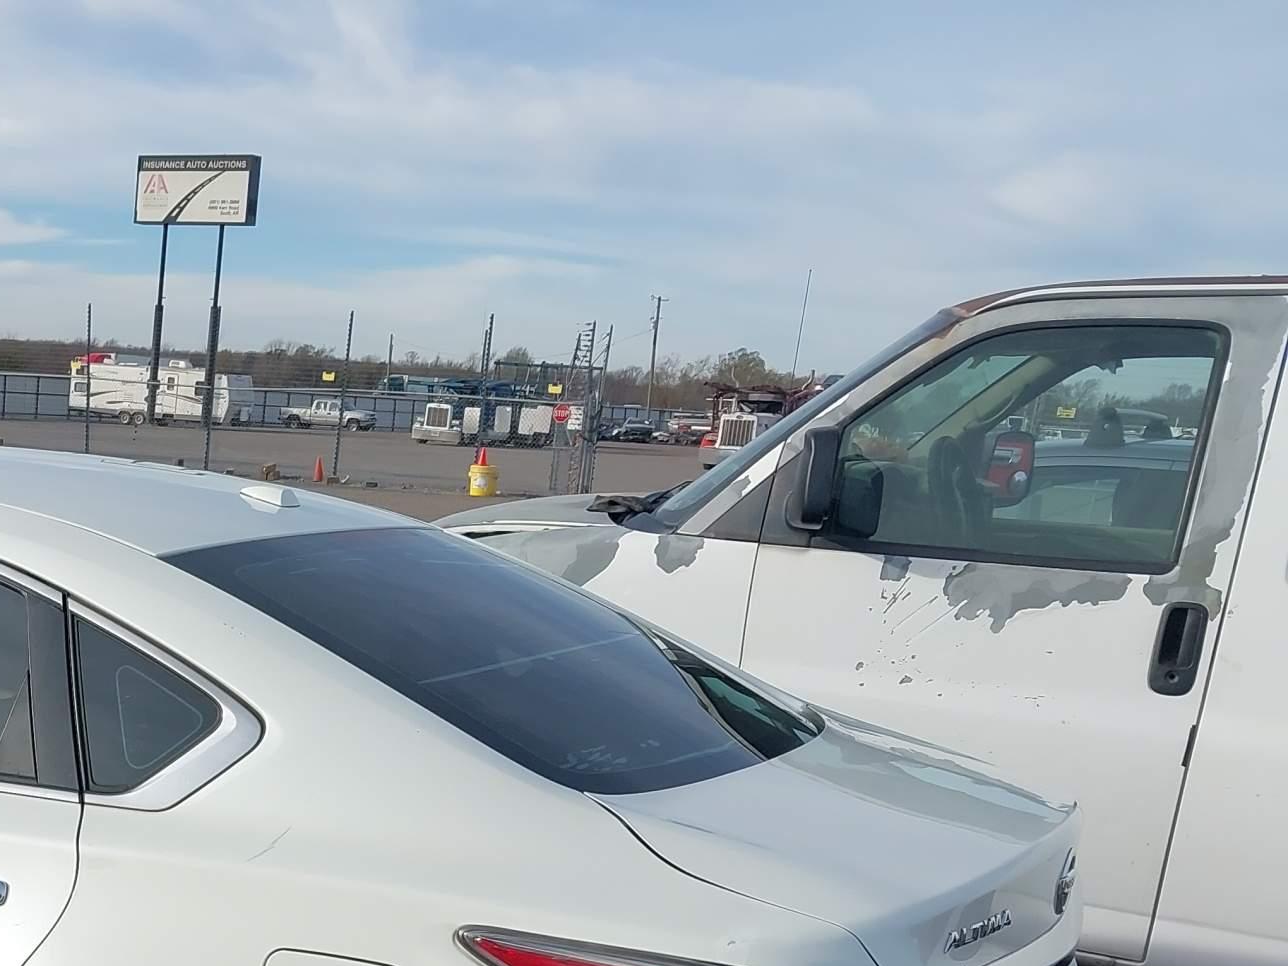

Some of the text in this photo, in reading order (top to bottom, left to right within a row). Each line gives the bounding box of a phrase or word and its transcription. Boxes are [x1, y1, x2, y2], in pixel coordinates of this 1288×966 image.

[143, 160, 247, 169] INSURANCE AUTO AUCTIONS
[554, 409, 569, 417] STOP
[944, 908, 1012, 953] ALTIMA
